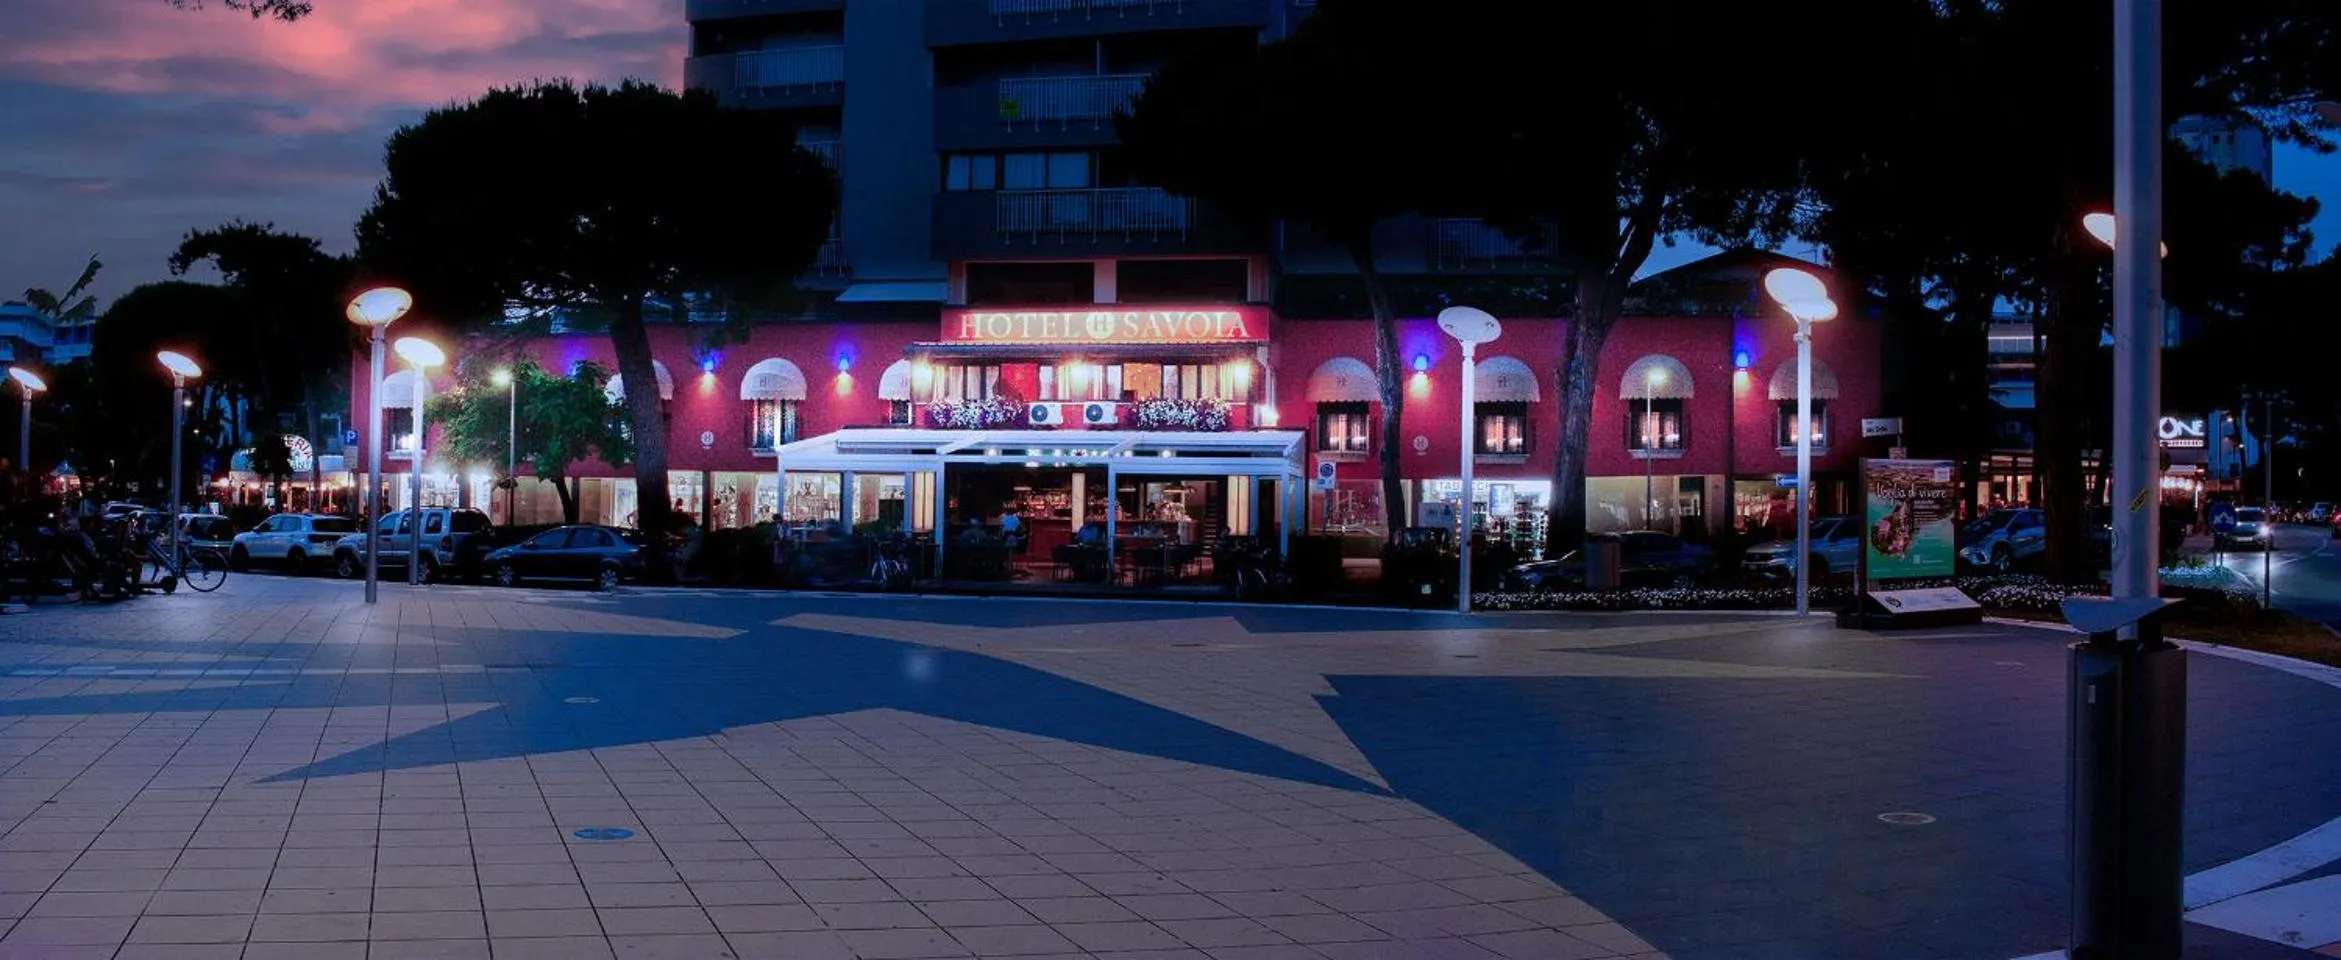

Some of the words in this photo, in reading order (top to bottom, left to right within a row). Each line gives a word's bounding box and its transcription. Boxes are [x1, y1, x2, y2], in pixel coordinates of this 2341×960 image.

[959, 312, 1080, 339] HOTEL
[1123, 311, 1250, 338] SAVOIA
[346, 430, 357, 443] P
[1918, 486, 1946, 499] vivere
